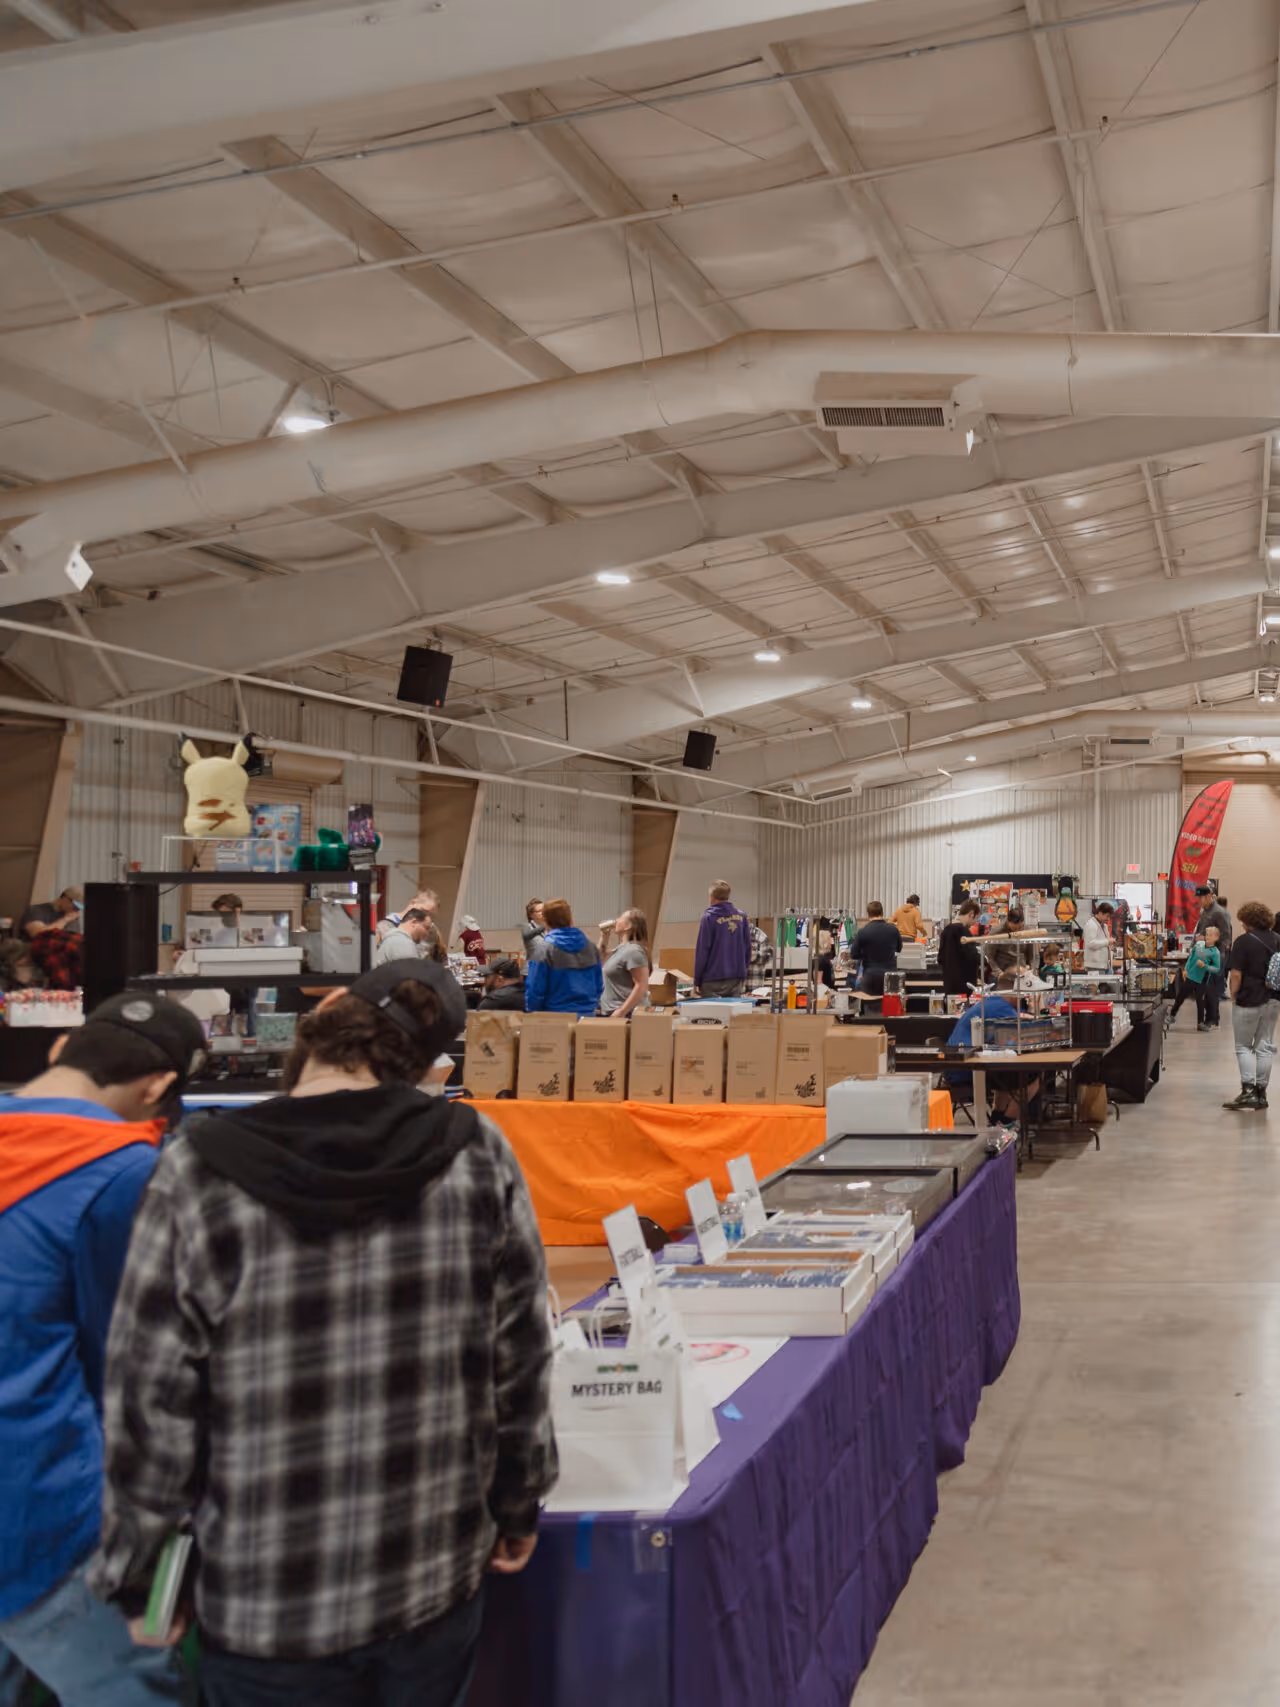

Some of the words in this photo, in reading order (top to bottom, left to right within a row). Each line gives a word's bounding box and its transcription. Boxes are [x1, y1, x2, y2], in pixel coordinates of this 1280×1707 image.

[1181, 832, 1197, 841] VIDEO
[1181, 862, 1198, 874] SELL
[571, 1382, 634, 1398] MYSTERY
[637, 1380, 662, 1395] BAG
